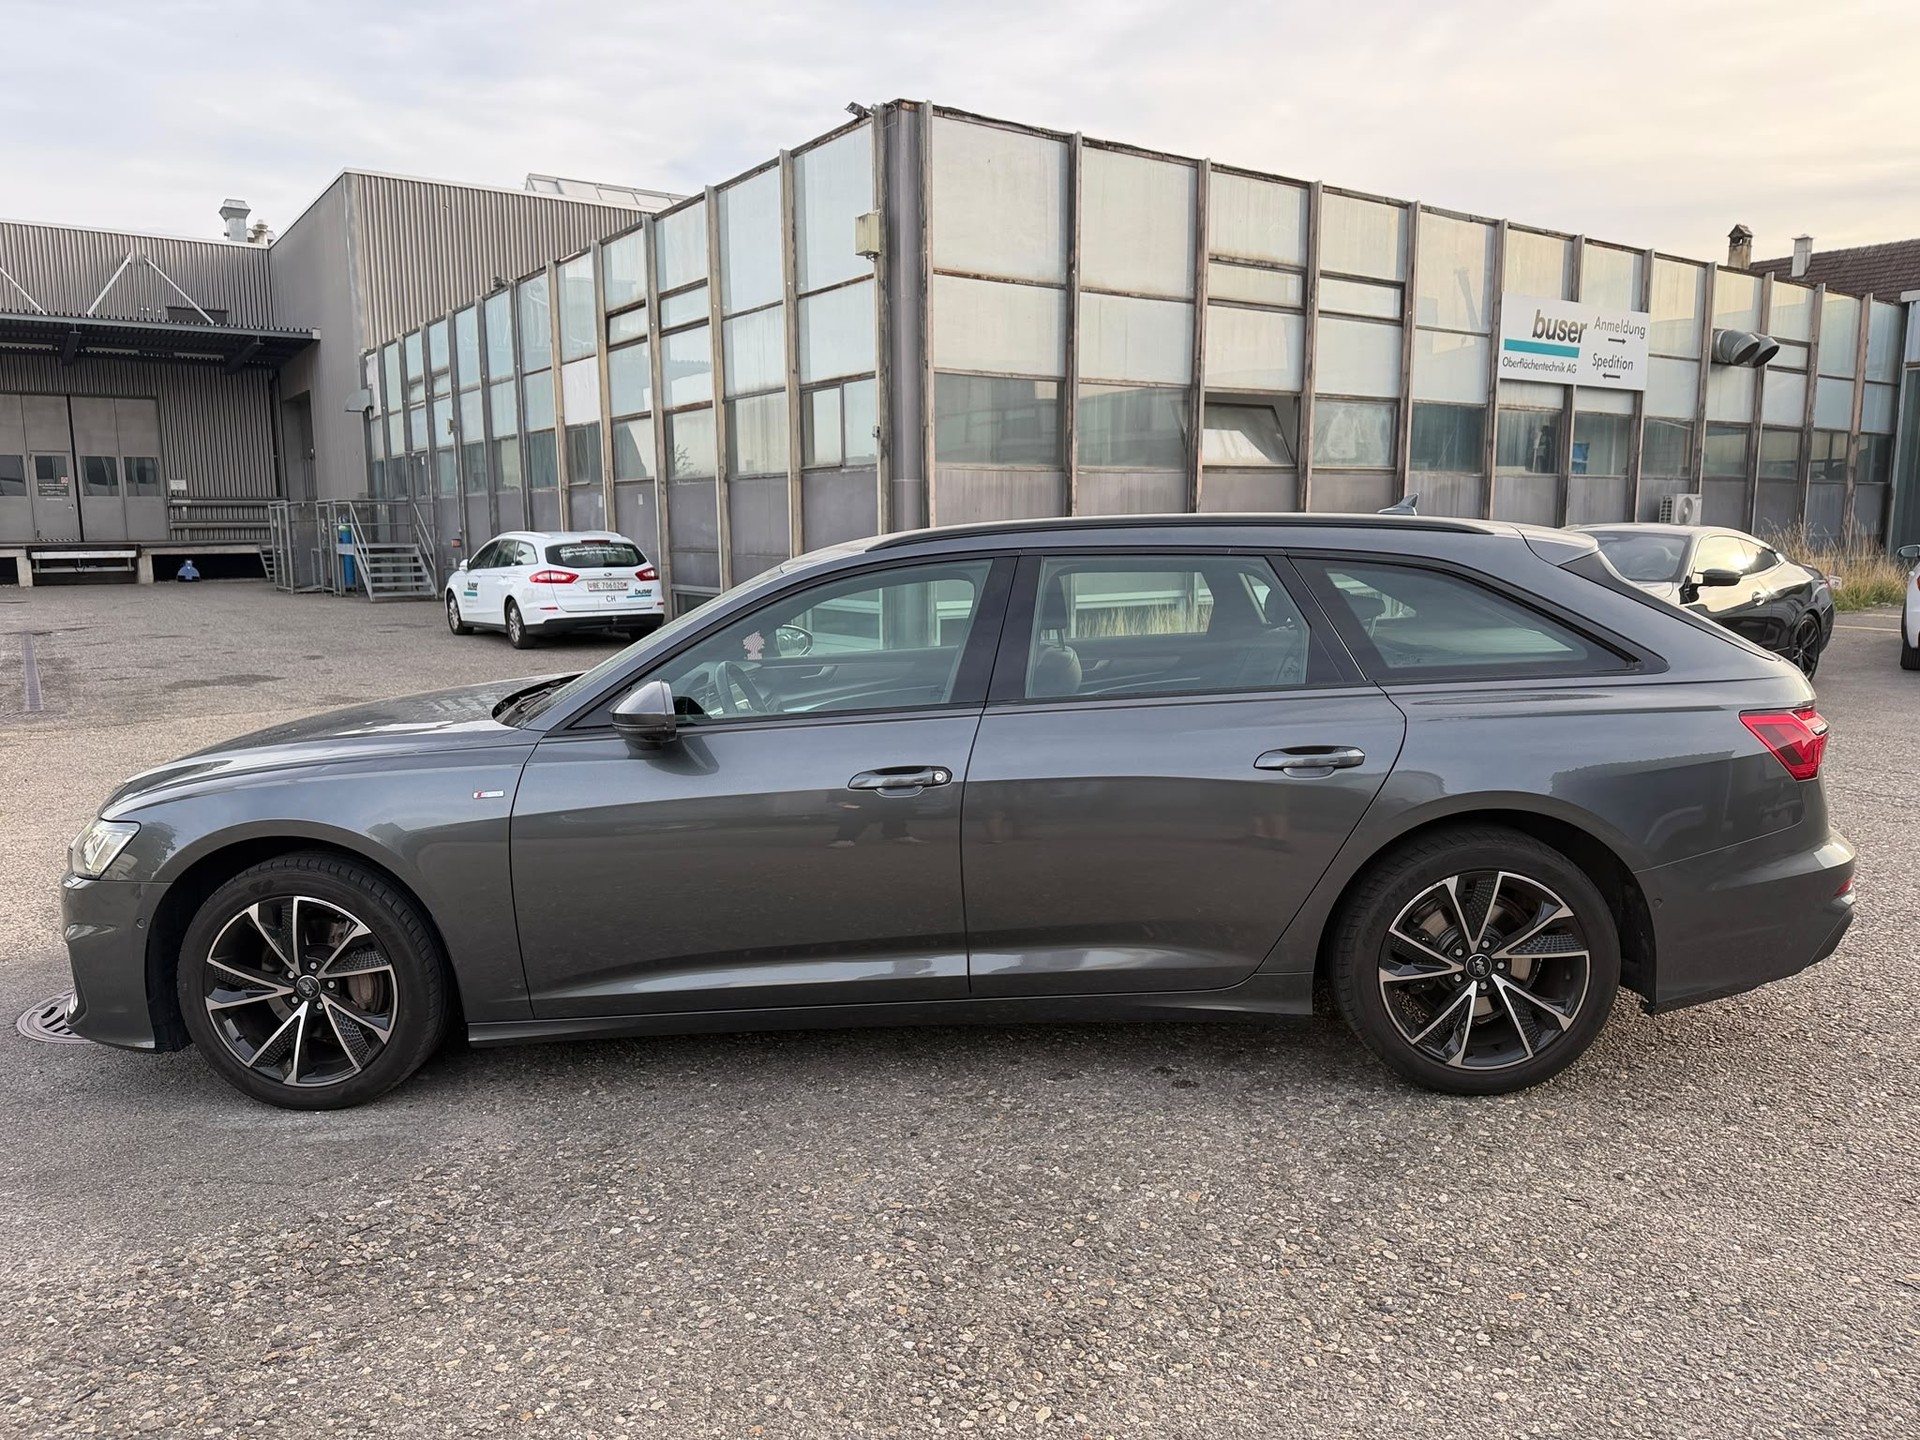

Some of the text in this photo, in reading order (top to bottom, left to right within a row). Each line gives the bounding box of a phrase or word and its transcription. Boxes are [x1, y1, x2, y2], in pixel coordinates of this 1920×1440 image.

[1532, 309, 1588, 343] buser
[1594, 316, 1646, 339] Anmeldung
[1566, 363, 1577, 374] AG
[1592, 352, 1634, 371] Spedition
